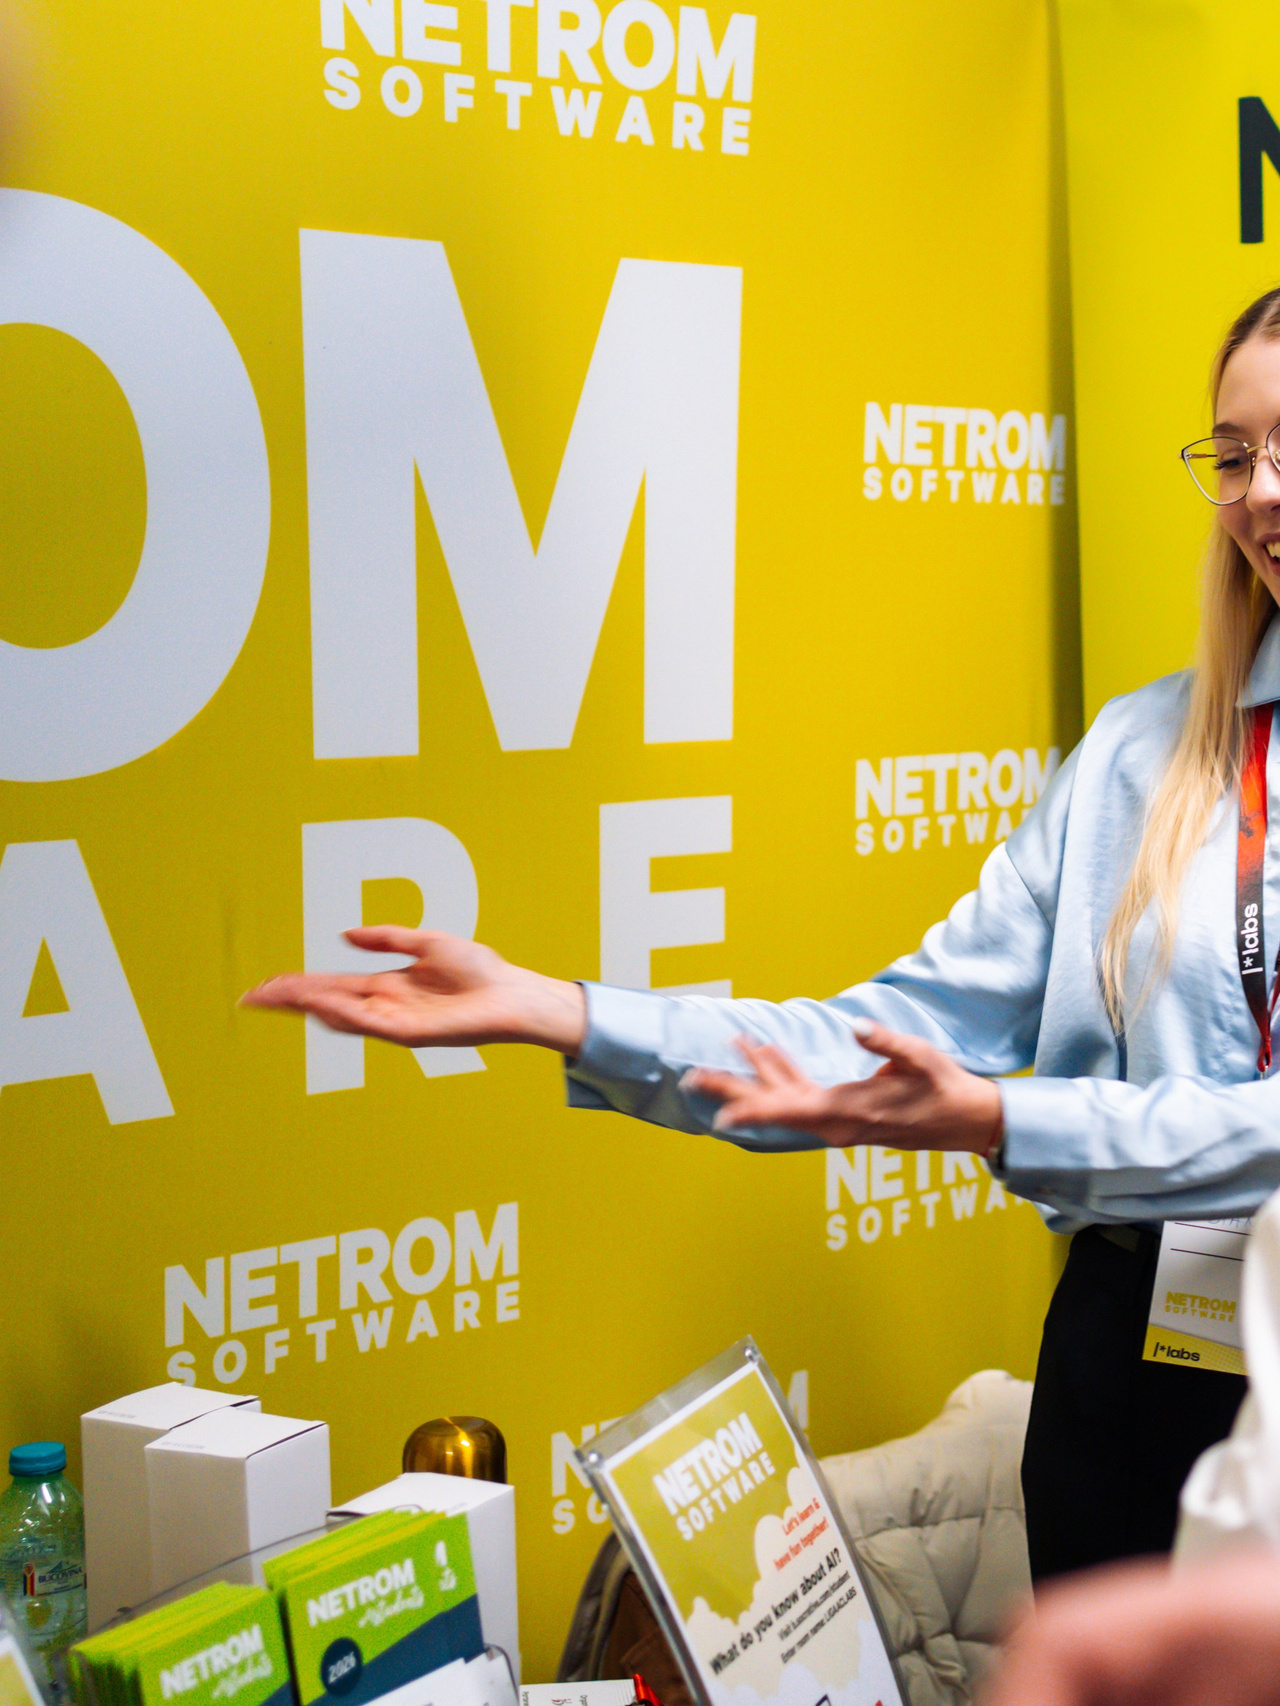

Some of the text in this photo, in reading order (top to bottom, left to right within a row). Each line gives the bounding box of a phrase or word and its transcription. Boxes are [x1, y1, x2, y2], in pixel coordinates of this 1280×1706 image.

[320, 0, 758, 103] NETROM
[322, 56, 751, 156] SOFTWARE
[863, 401, 1066, 472] NETROM
[862, 465, 1065, 505] SOFTWARE
[855, 808, 1031, 856] SOFTWA
[164, 1202, 520, 1348] NETROM
[1164, 1304, 1236, 1323] SOFTWARE
[1165, 1291, 1237, 1314] NETROM
[166, 1281, 520, 1388] SOFTWARE
[653, 1412, 764, 1516] NETROM
[676, 1451, 776, 1541] SOFTWARE
[306, 1557, 416, 1628] NETROM
[710, 1547, 842, 1676] What do you know about AI?
[159, 1623, 265, 1700] NETROM
